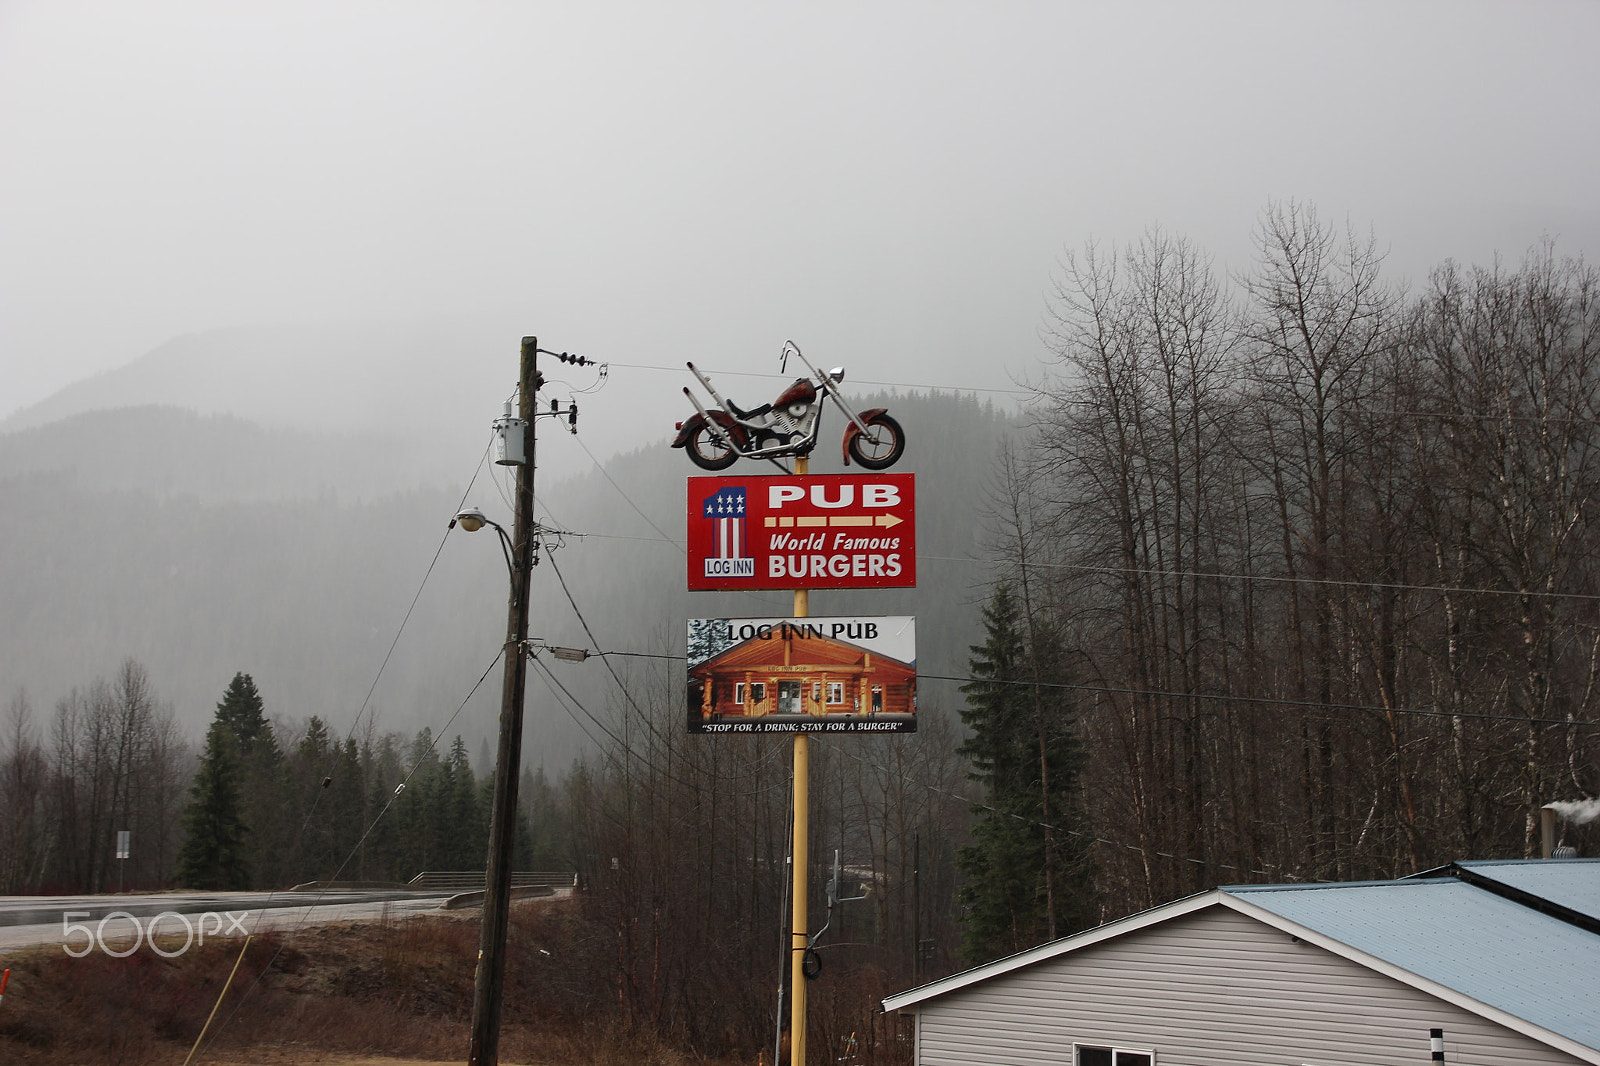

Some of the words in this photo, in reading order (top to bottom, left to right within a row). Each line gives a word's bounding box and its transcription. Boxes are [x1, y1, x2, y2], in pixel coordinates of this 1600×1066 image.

[768, 484, 902, 508] PUB
[770, 533, 826, 550] World
[833, 533, 900, 550] Famous
[707, 560, 730, 574] LOG
[733, 560, 752, 574] INN
[768, 554, 902, 578] BURGERS
[728, 624, 772, 641] LOG
[781, 623, 823, 640] INN
[831, 622, 879, 640] PUB
[733, 723, 753, 732] FOR
[754, 723, 762, 732] A
[800, 722, 824, 732] STAY
[826, 722, 845, 731] FOR
[847, 722, 855, 731] A
